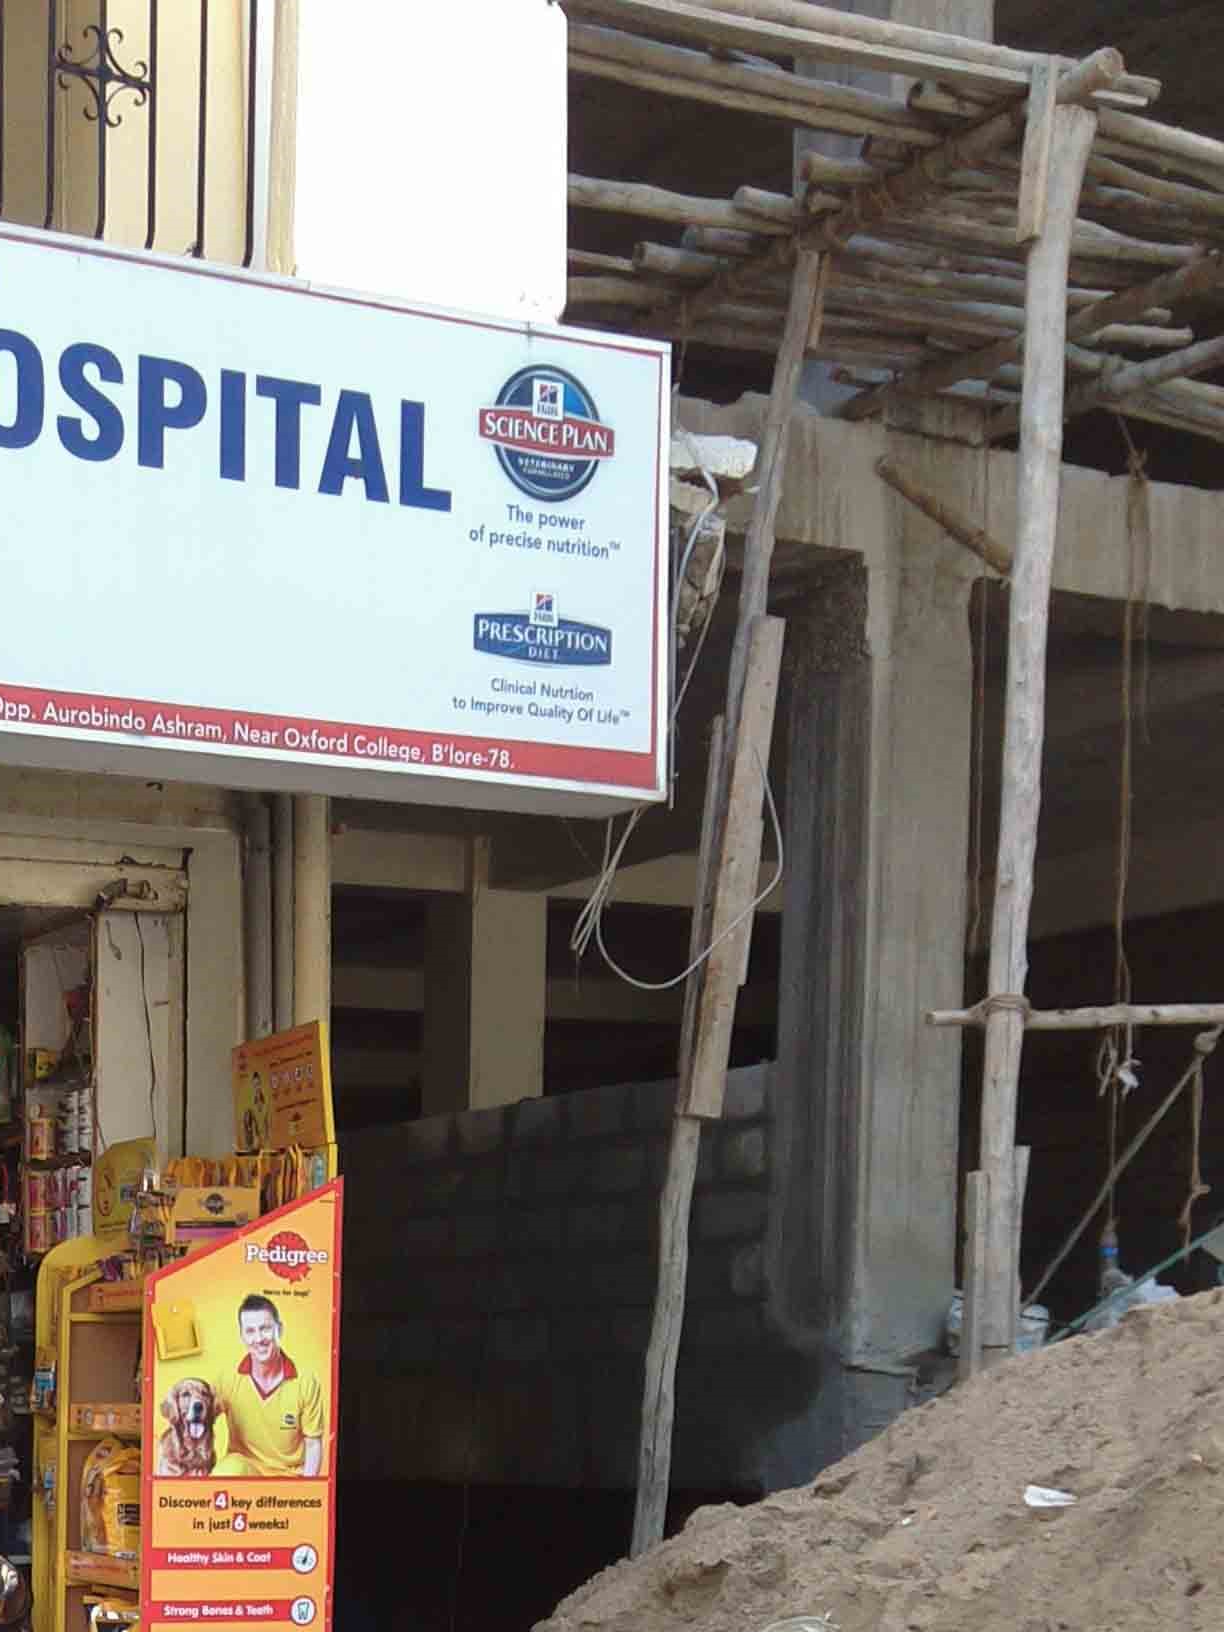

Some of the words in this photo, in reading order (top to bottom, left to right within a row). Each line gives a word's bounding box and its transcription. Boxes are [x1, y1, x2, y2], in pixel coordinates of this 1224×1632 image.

[484, 411, 559, 447] SCIENCE
[506, 504, 534, 524] The
[538, 512, 586, 531] power
[469, 525, 486, 542] of
[489, 531, 542, 550] precise
[477, 618, 608, 653] PRESCRIPTION
[528, 646, 559, 660] DIET
[491, 678, 536, 696] Clinical
[452, 696, 466, 709] to
[471, 696, 523, 716] Improve
[528, 702, 573, 724] Quality
[577, 706, 594, 722] Of
[42, 701, 146, 732] Aurobindo
[151, 714, 228, 744] Ashram,
[234, 723, 279, 746] Near
[284, 727, 349, 753] Oxford
[354, 735, 426, 763] College,
[246, 1243, 328, 1266] Pedigree
[159, 1496, 212, 1509] Discover
[215, 1493, 226, 1508] 4
[231, 1497, 252, 1511] key
[256, 1495, 322, 1509] differences
[193, 1518, 204, 1530] in
[209, 1518, 231, 1532] just
[234, 1515, 245, 1531] 6
[248, 1517, 289, 1531] weeks!
[167, 1551, 209, 1566] Healthy
[212, 1551, 235, 1564] Skin
[237, 1552, 244, 1563] &
[247, 1552, 272, 1564] Coat
[163, 1605, 199, 1618] Strong
[202, 1605, 233, 1616] Bones
[235, 1605, 244, 1616] &
[246, 1605, 274, 1616] Teeth
